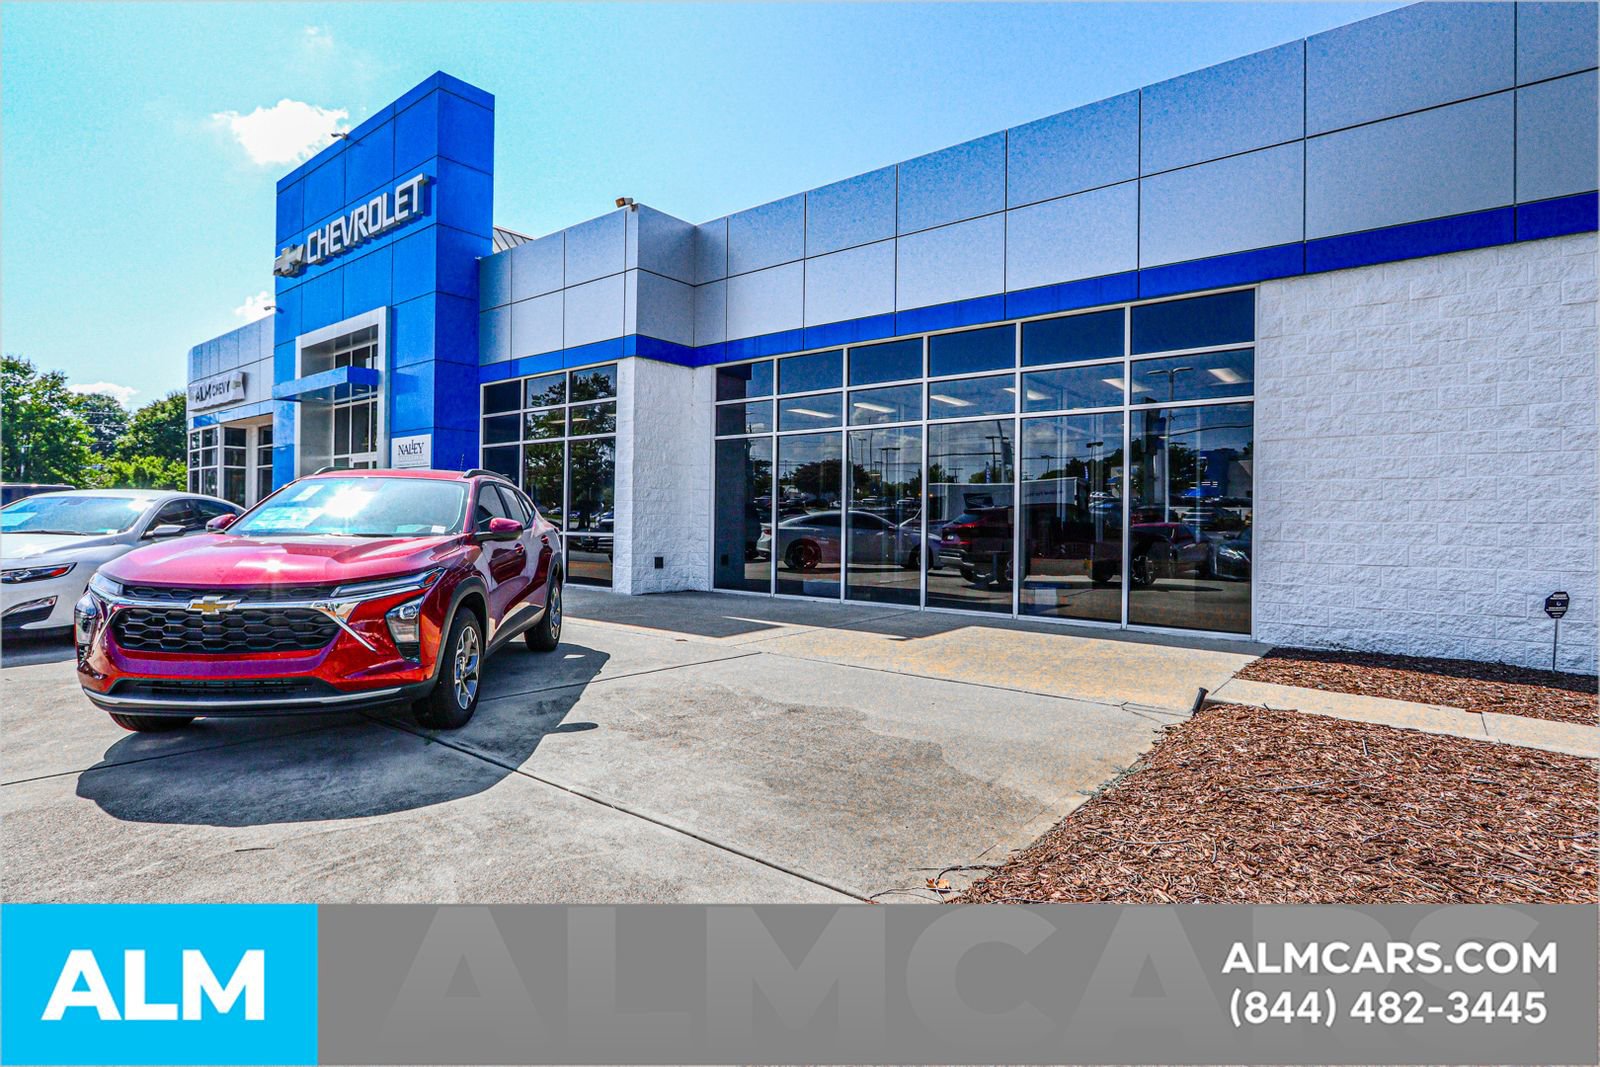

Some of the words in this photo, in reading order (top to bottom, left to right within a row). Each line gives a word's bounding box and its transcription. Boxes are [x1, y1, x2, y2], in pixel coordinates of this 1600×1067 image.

[307, 172, 427, 265] CHEVROLET
[195, 383, 211, 403] ALM
[212, 380, 231, 397] CHEVY
[397, 439, 425, 456] NALLEY
